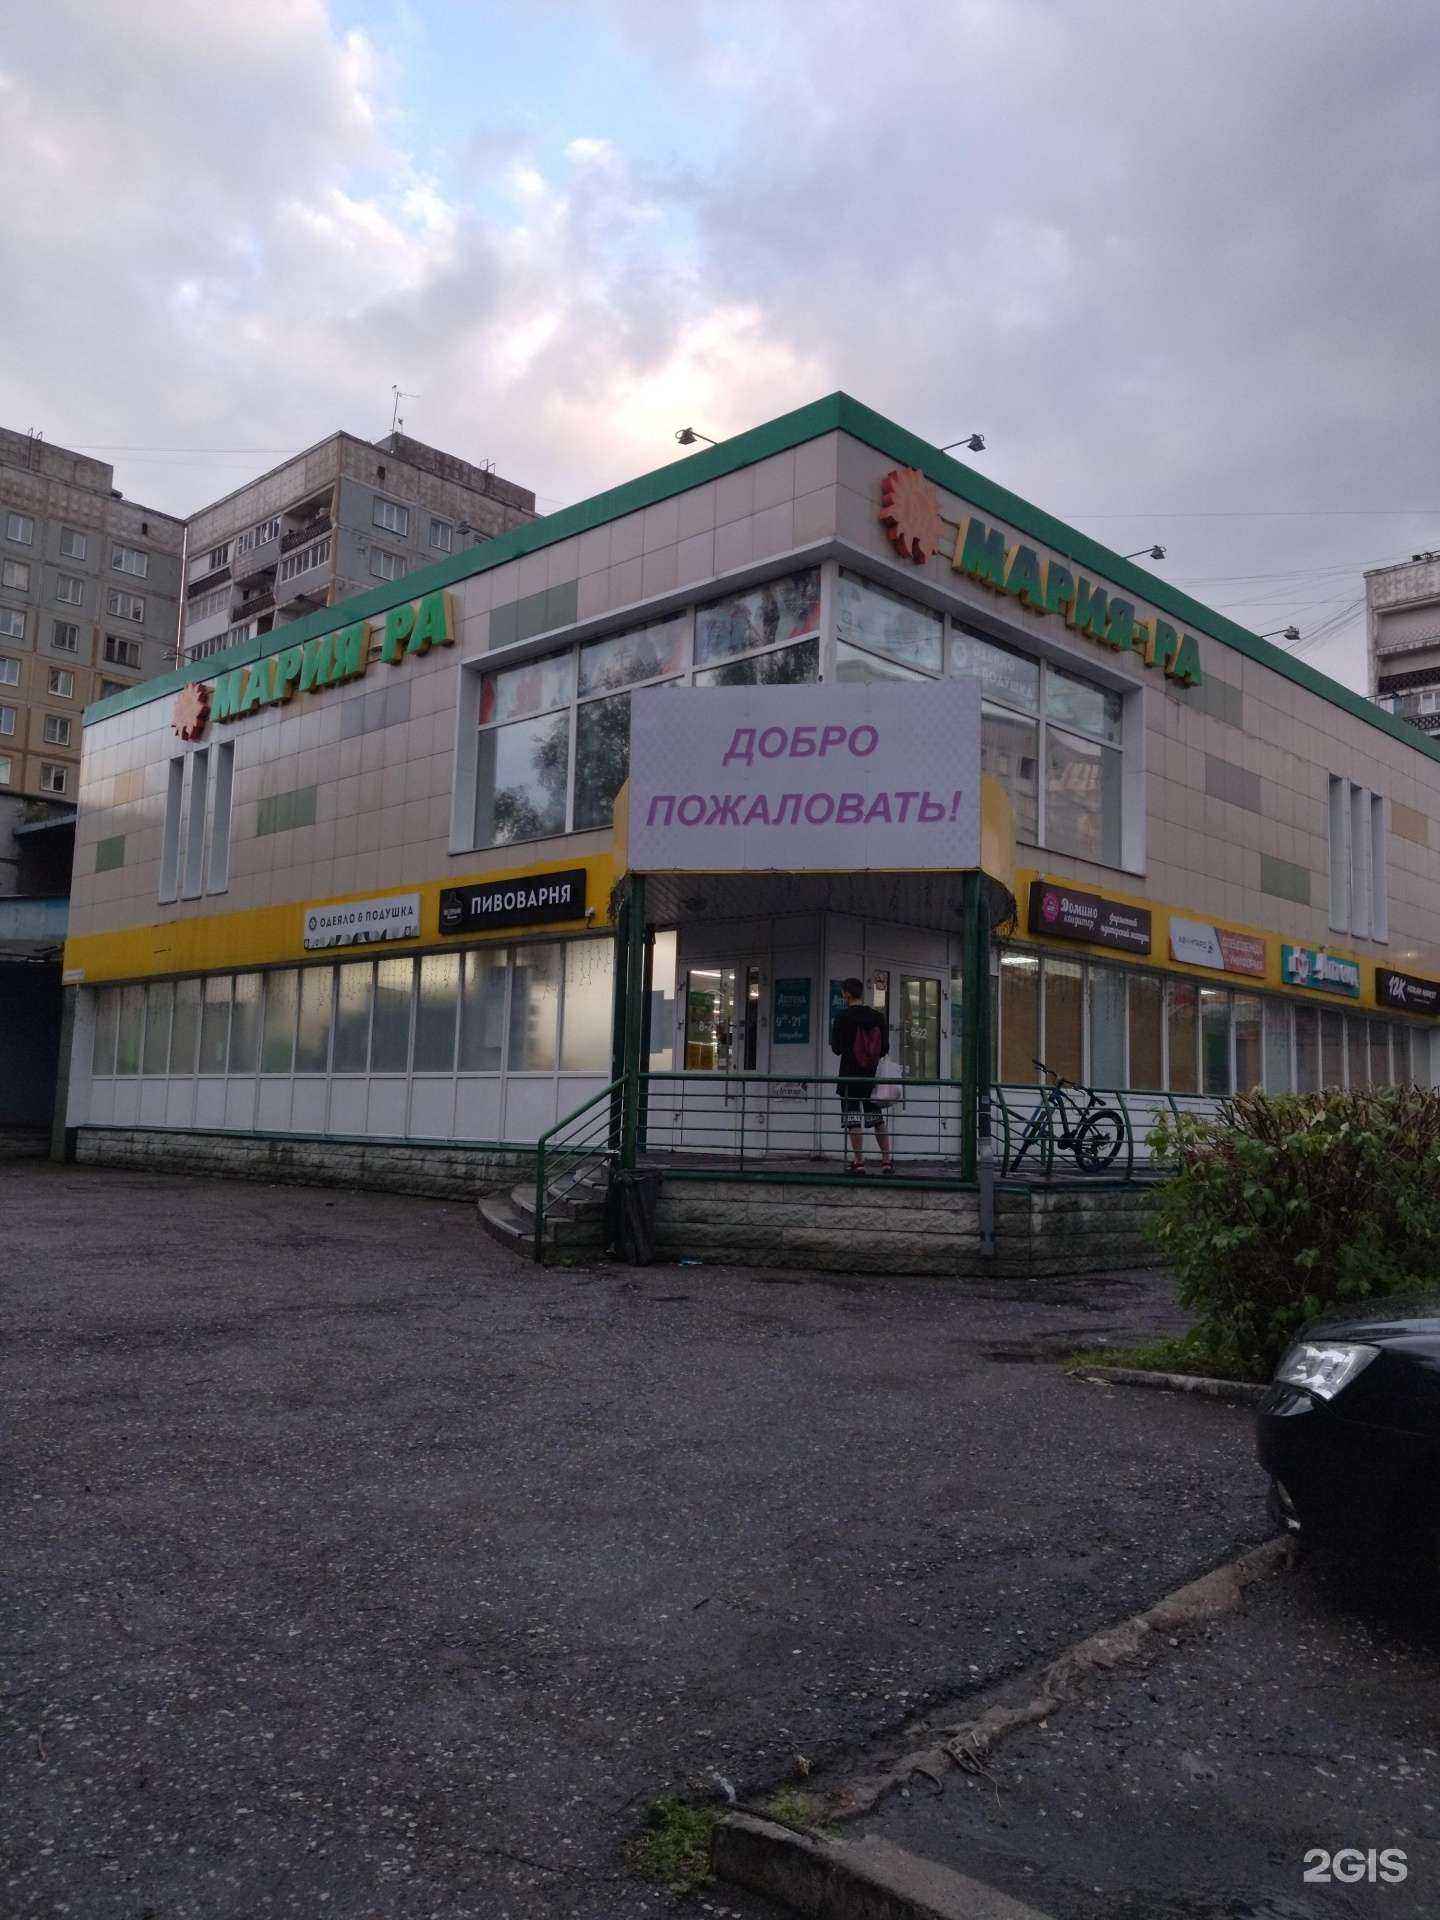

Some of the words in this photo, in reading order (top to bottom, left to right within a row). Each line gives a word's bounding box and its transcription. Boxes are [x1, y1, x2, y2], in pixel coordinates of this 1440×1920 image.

[952, 516, 1200, 688] МАРИЯ-РА
[210, 590, 454, 723] МАРИЯРА
[722, 725, 879, 767] ДОБРО
[646, 790, 962, 826] ПОЖАЛОВАТЬ!
[320, 912, 355, 928] ОДЕЯЛО
[366, 905, 414, 921] ПОДУШКА
[471, 884, 571, 915] ПИВОВАРНЯ
